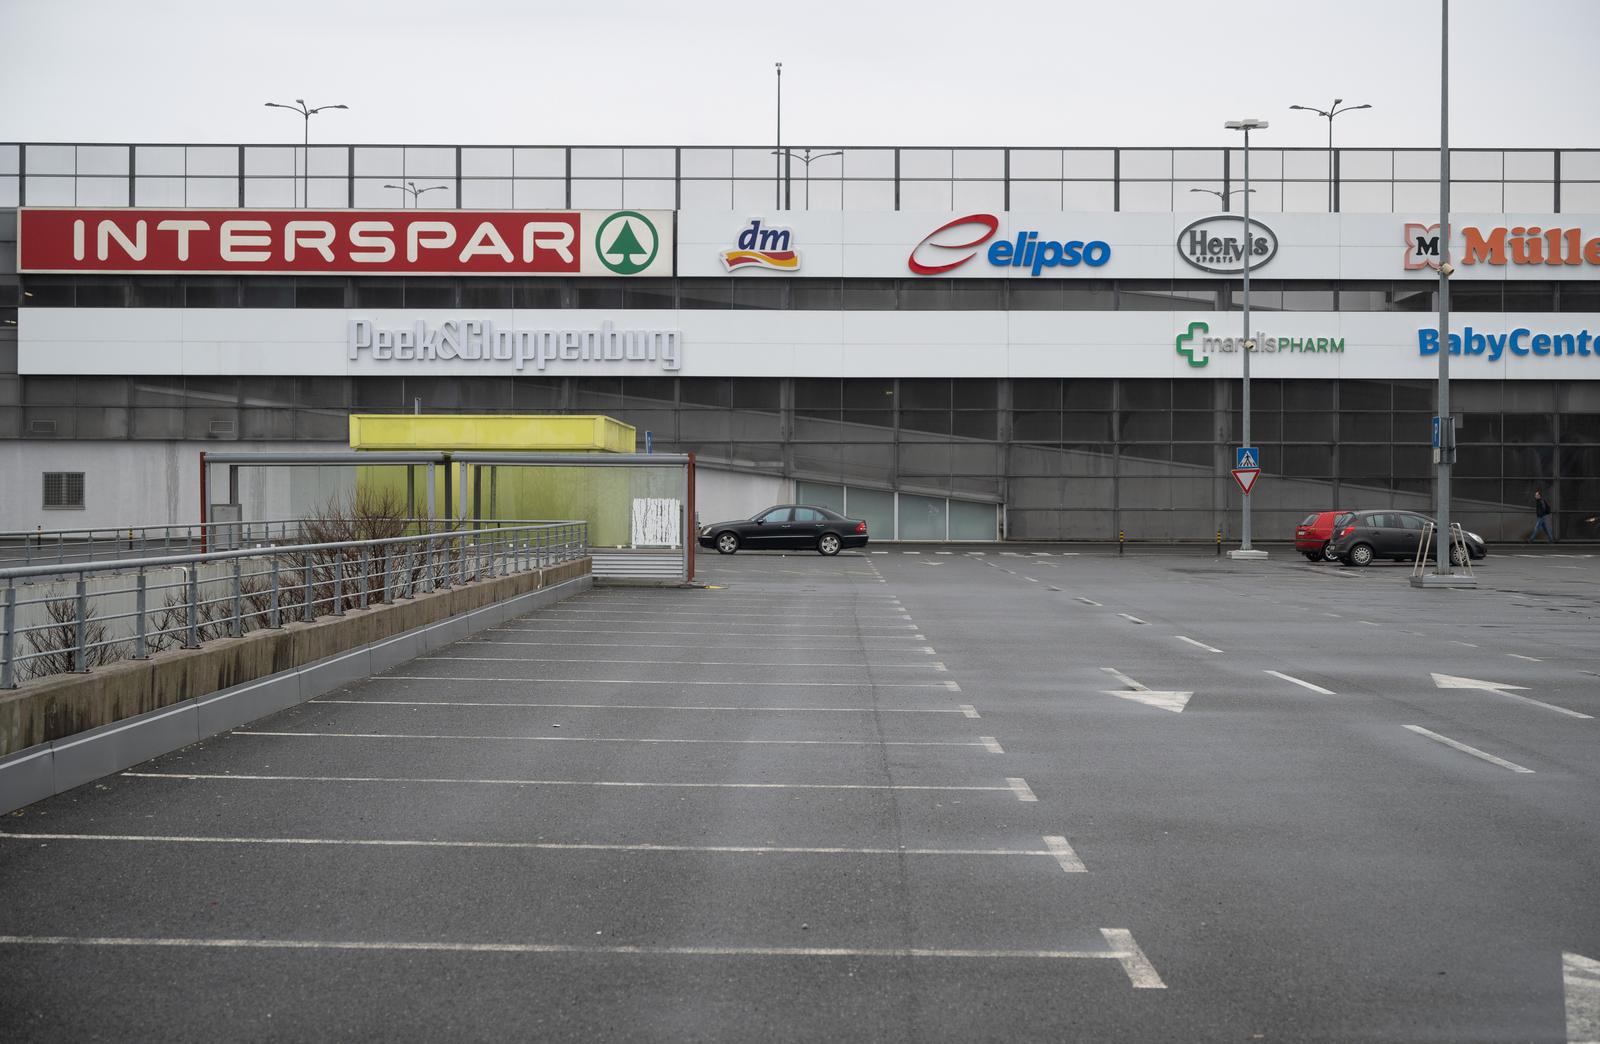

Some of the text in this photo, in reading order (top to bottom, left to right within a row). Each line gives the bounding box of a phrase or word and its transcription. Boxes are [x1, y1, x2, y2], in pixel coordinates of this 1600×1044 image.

[74, 219, 575, 264] INTERSPAR
[738, 220, 790, 251] dm
[988, 231, 1112, 277] elipso
